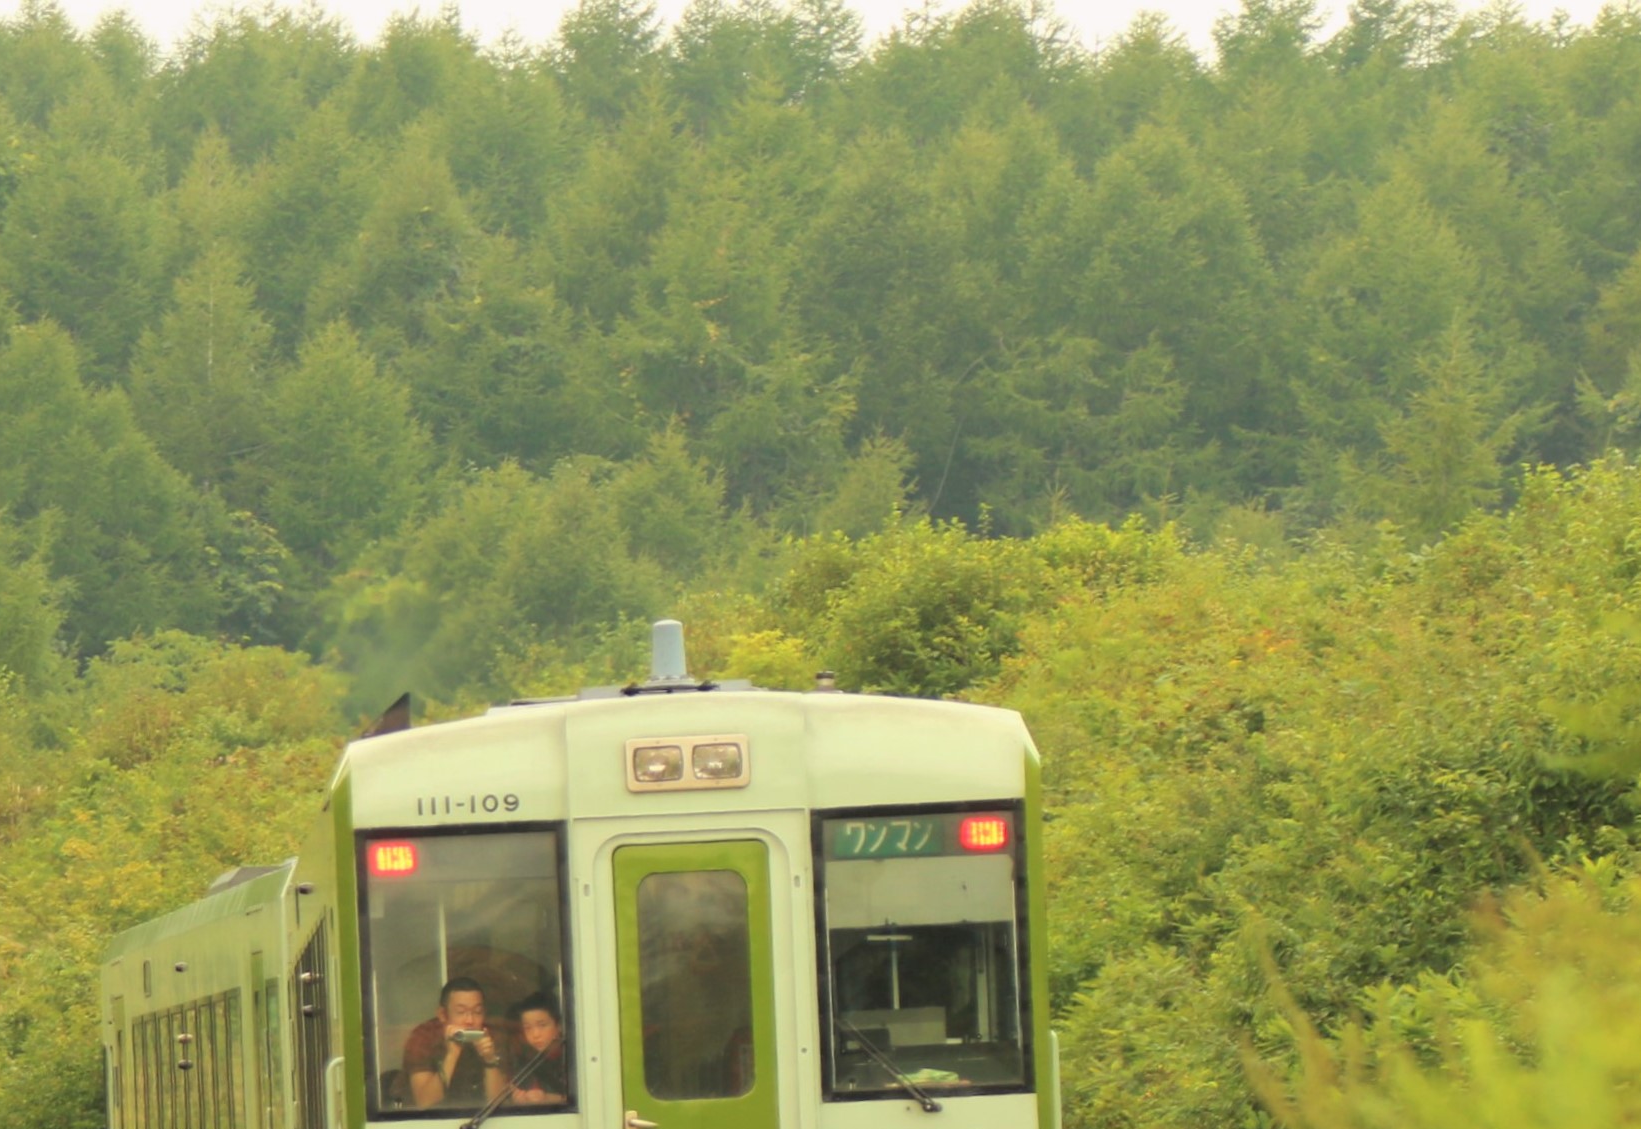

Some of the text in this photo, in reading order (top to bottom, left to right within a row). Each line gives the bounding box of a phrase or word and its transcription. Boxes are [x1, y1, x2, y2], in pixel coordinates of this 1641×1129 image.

[417, 793, 520, 816] 111-109
[845, 820, 933, 854] ワンマン
